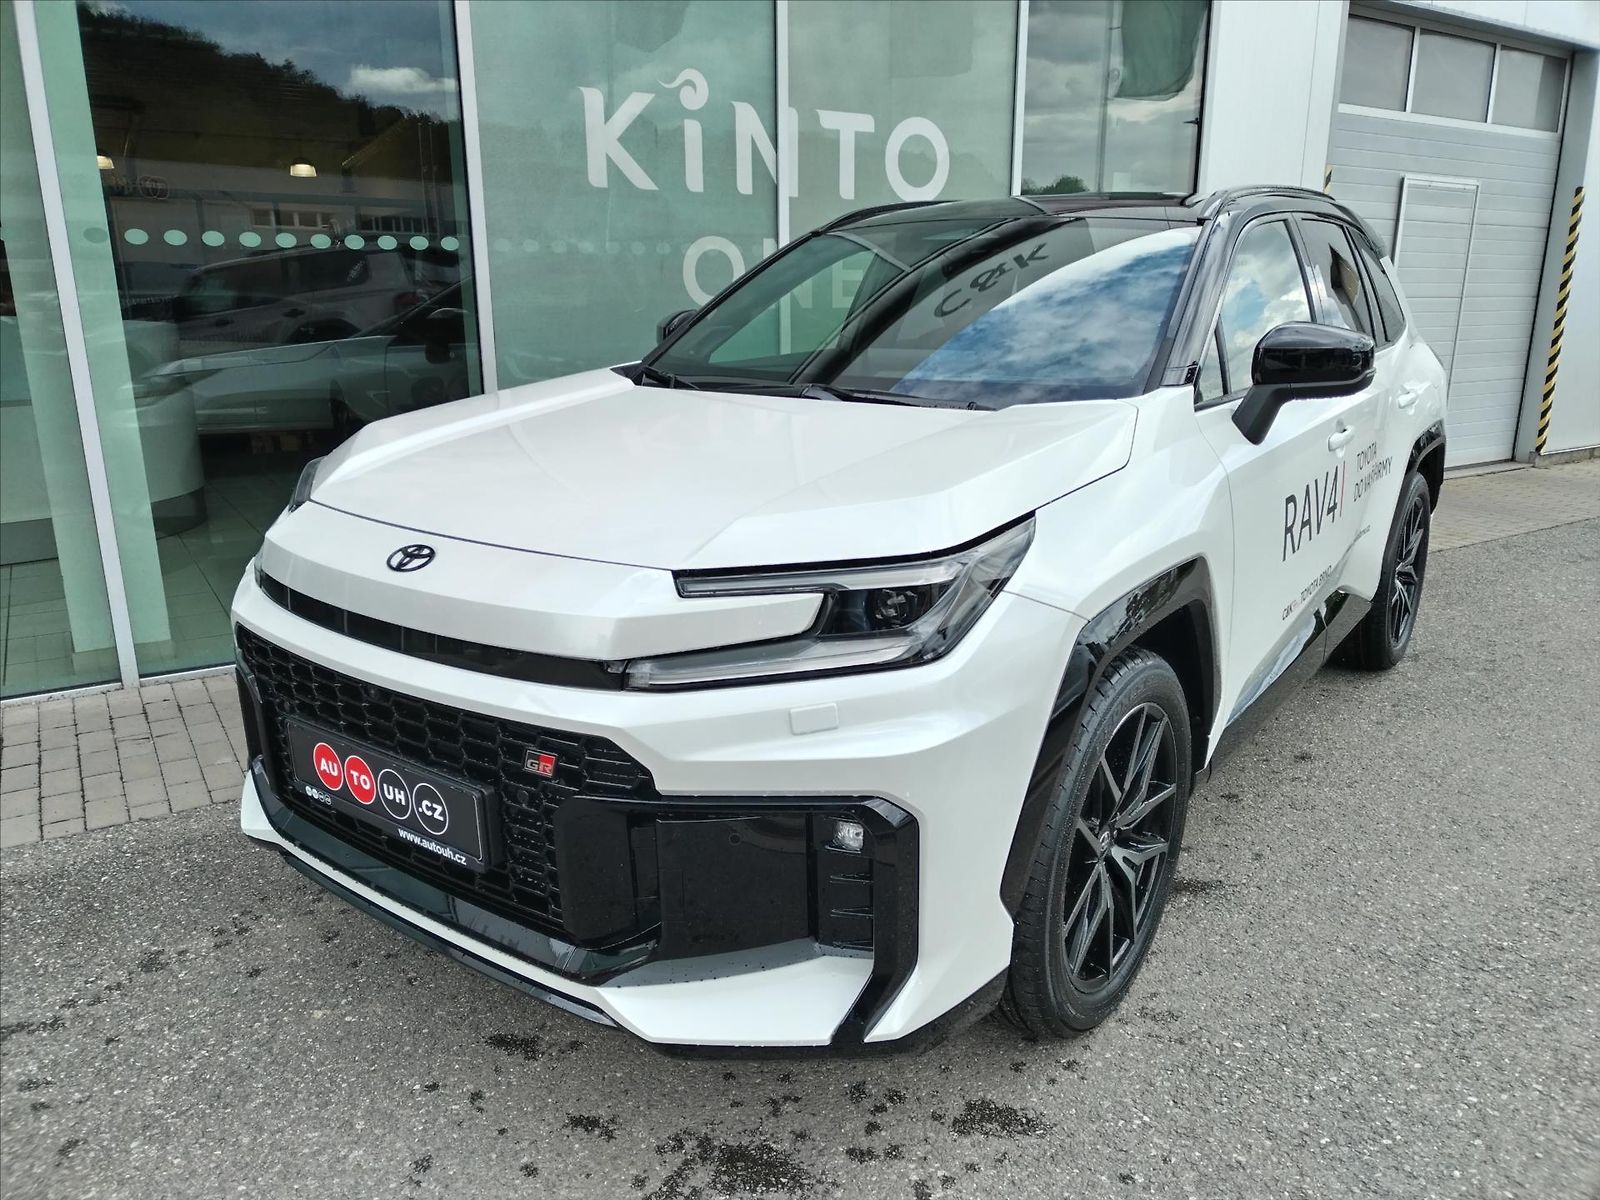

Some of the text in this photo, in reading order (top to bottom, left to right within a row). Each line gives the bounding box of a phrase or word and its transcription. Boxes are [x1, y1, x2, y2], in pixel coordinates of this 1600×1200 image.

[1282, 465, 1339, 562] RAV4
[320, 757, 339, 777] AU
[350, 770, 371, 790] TO
[383, 783, 406, 806] UH
[526, 758, 552, 775] GR
[398, 828, 467, 866] www.autouh.cz
